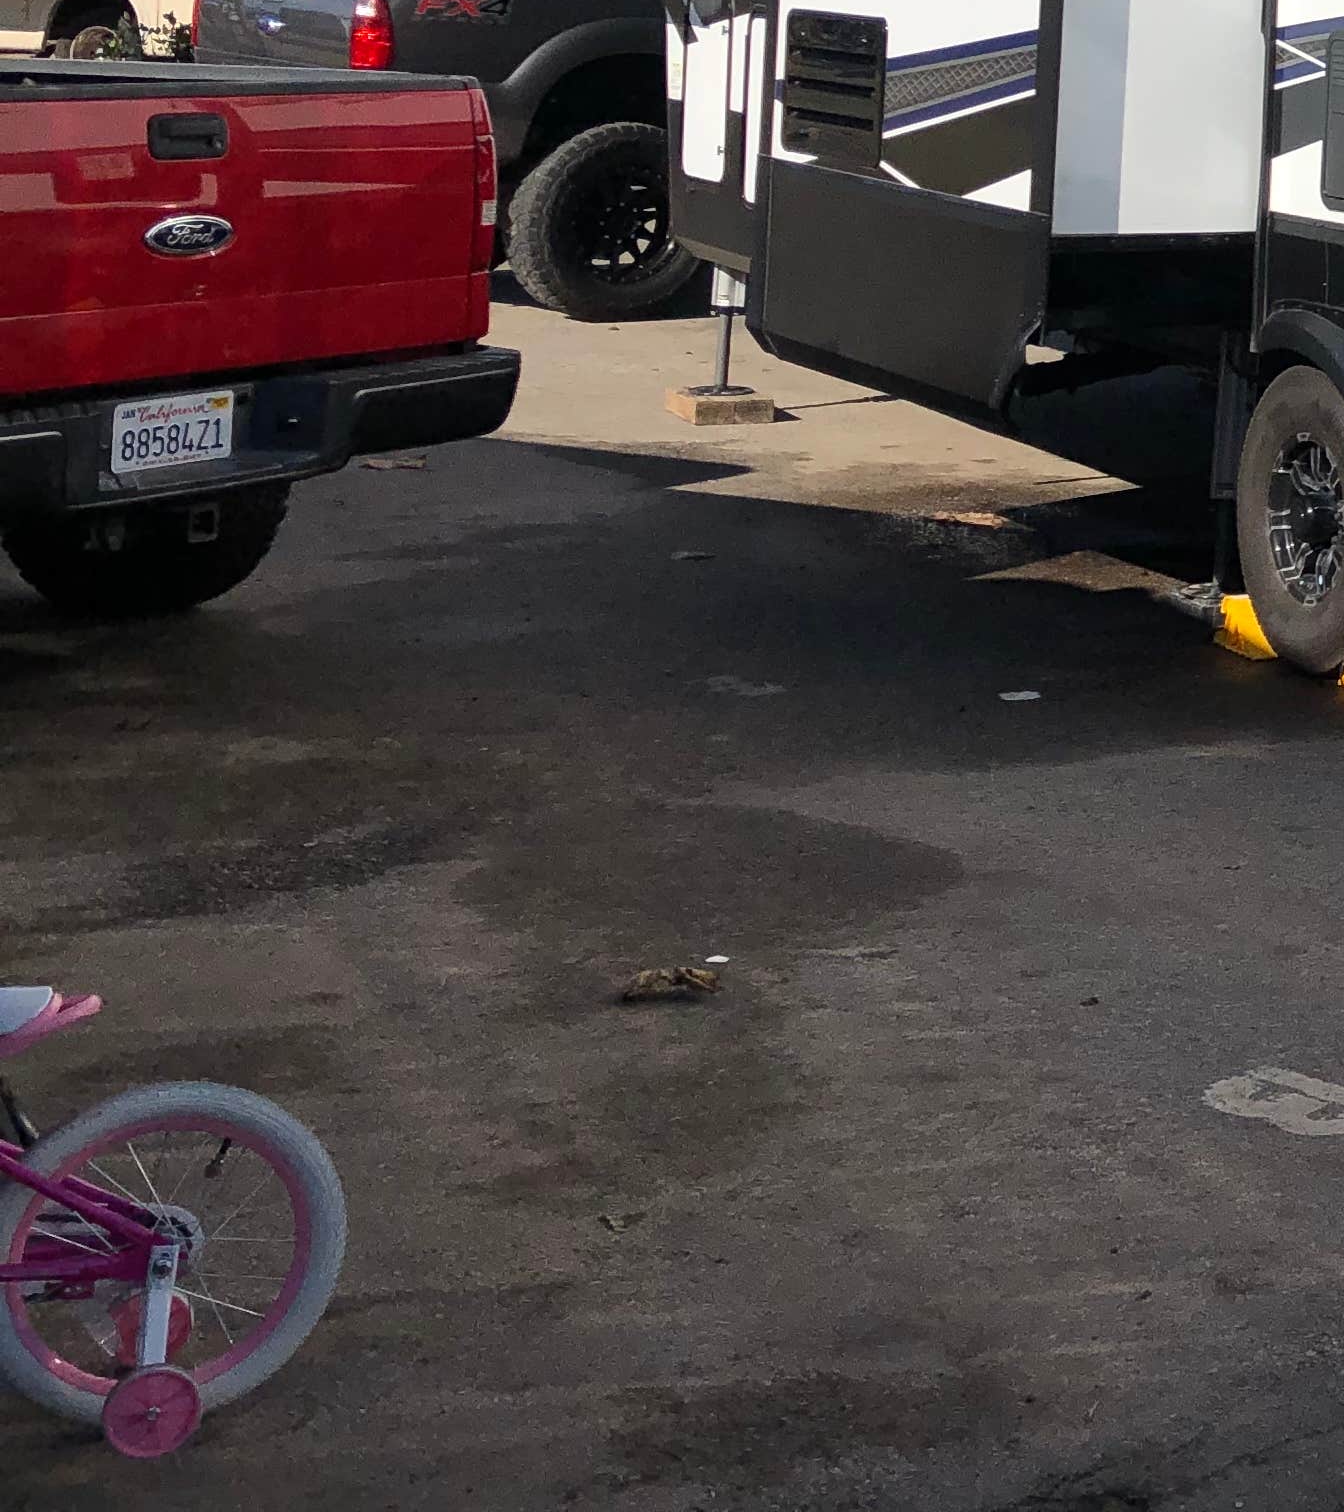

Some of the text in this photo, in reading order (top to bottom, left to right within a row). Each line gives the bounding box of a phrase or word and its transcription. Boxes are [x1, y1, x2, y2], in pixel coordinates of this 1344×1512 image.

[167, 223, 215, 245] Ford
[121, 408, 136, 420] JAN
[137, 402, 209, 423] California
[121, 417, 224, 462] 88584Z1
